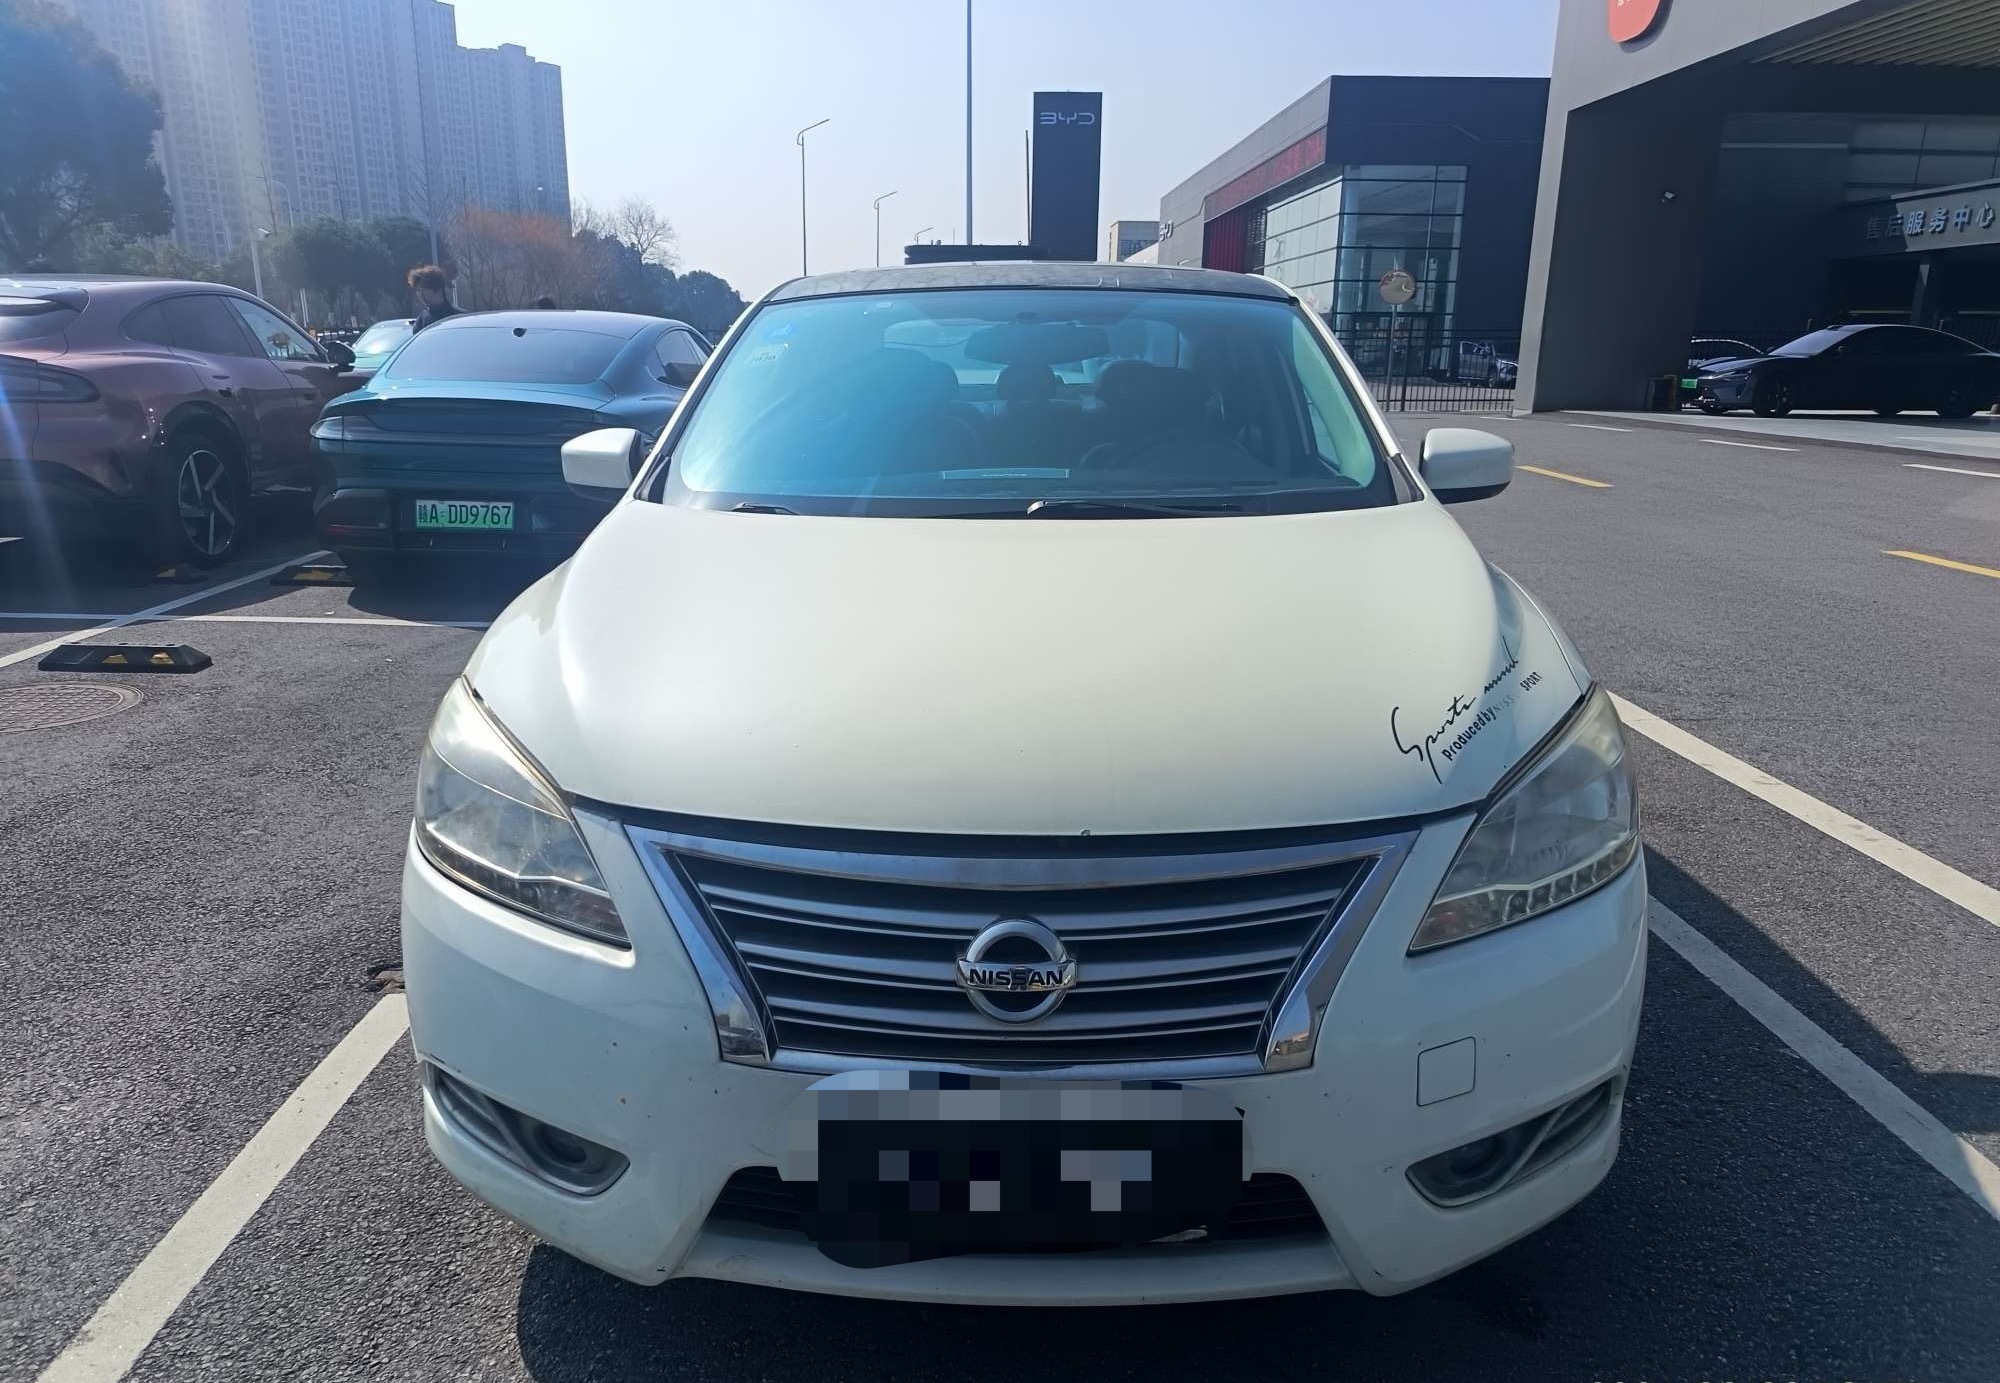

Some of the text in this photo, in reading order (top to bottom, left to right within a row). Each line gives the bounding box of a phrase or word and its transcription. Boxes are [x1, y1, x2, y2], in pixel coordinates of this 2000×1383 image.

[1040, 112, 1096, 125] BYD
[1866, 202, 1994, 239] 售后服务中心
[968, 967, 1063, 988] NISSAN
